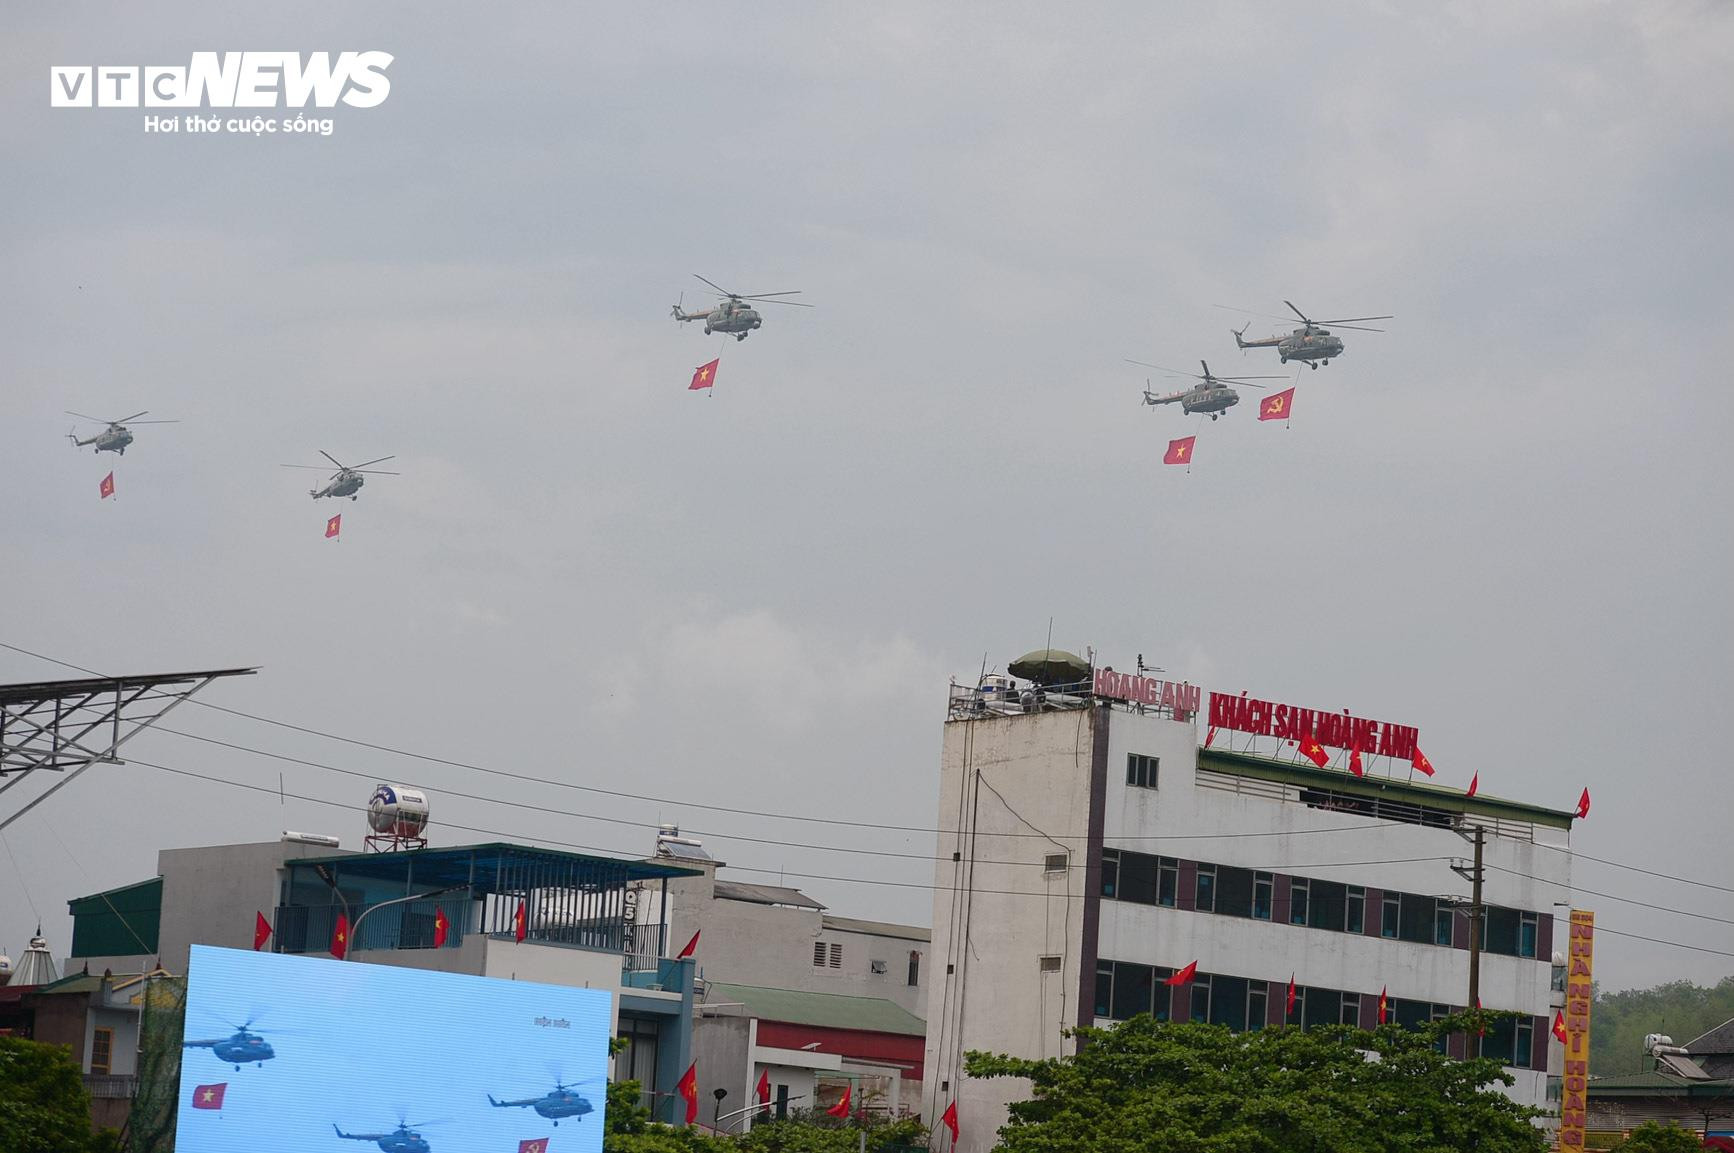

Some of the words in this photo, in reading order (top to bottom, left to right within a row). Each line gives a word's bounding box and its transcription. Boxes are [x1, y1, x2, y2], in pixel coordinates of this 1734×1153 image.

[1160, 681, 1201, 712] ANH
[1209, 690, 1273, 736] KHÁCH
[1274, 704, 1315, 746] SẠN
[1316, 708, 1378, 754] HOÀNG
[1379, 722, 1419, 761] ANH
[1570, 923, 1593, 976] NHÀ
[1563, 1061, 1586, 1145] HOÀNG
